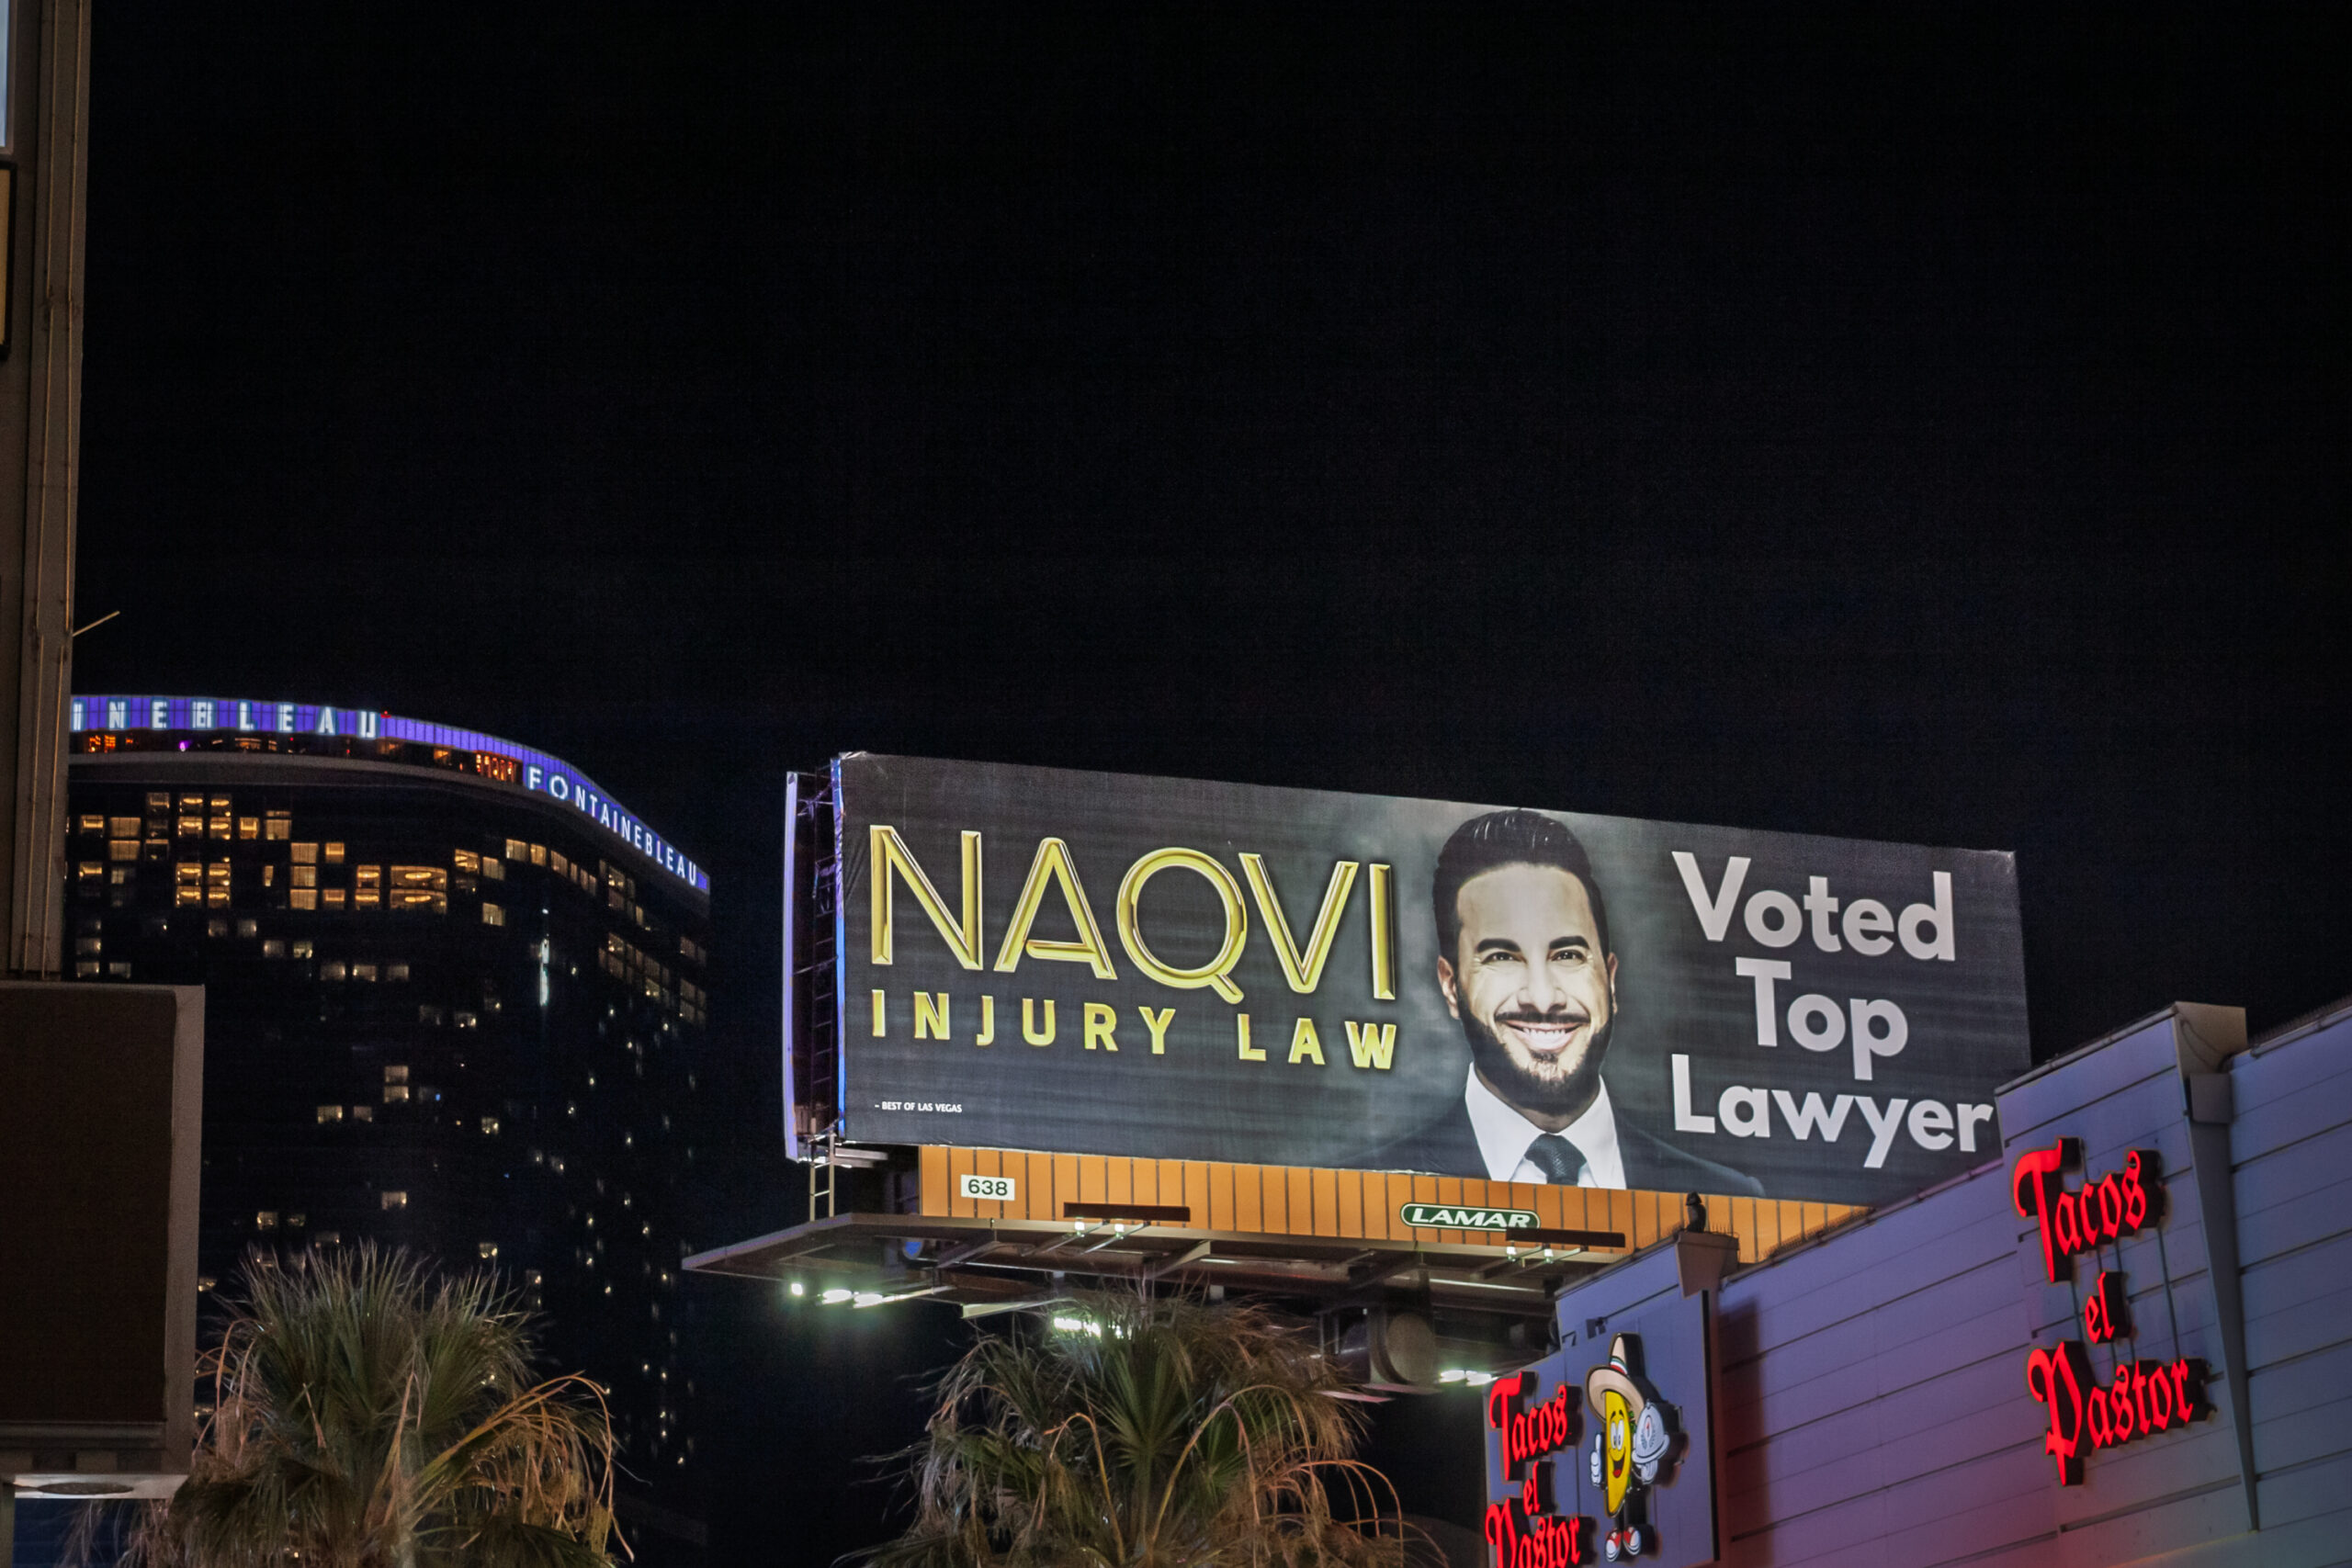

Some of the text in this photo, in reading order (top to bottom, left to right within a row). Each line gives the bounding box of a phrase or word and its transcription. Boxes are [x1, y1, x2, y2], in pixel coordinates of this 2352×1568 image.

[527, 764, 698, 886] FONTAINEBLEAU
[869, 824, 1396, 1005] NAQVI
[1671, 851, 1956, 962] Voted
[871, 988, 1397, 1070] INJURY LAW
[1736, 956, 1909, 1081] Top
[881, 1101, 902, 1111] BEST
[904, 1102, 916, 1111] OF
[918, 1102, 933, 1111] LAS
[935, 1103, 963, 1113] VEGAS
[1671, 1054, 1995, 1169] Lawyer
[967, 1179, 1008, 1197] 638
[1412, 1207, 1531, 1228] LAMAR
[2014, 1139, 2146, 1282] Tacos
[2085, 1271, 2115, 1344] el
[1489, 1372, 1568, 1481] Tacos
[2027, 1341, 2194, 1486] Pastor
[1485, 1497, 1580, 1568] Pastor
[1522, 1461, 1541, 1517] el
